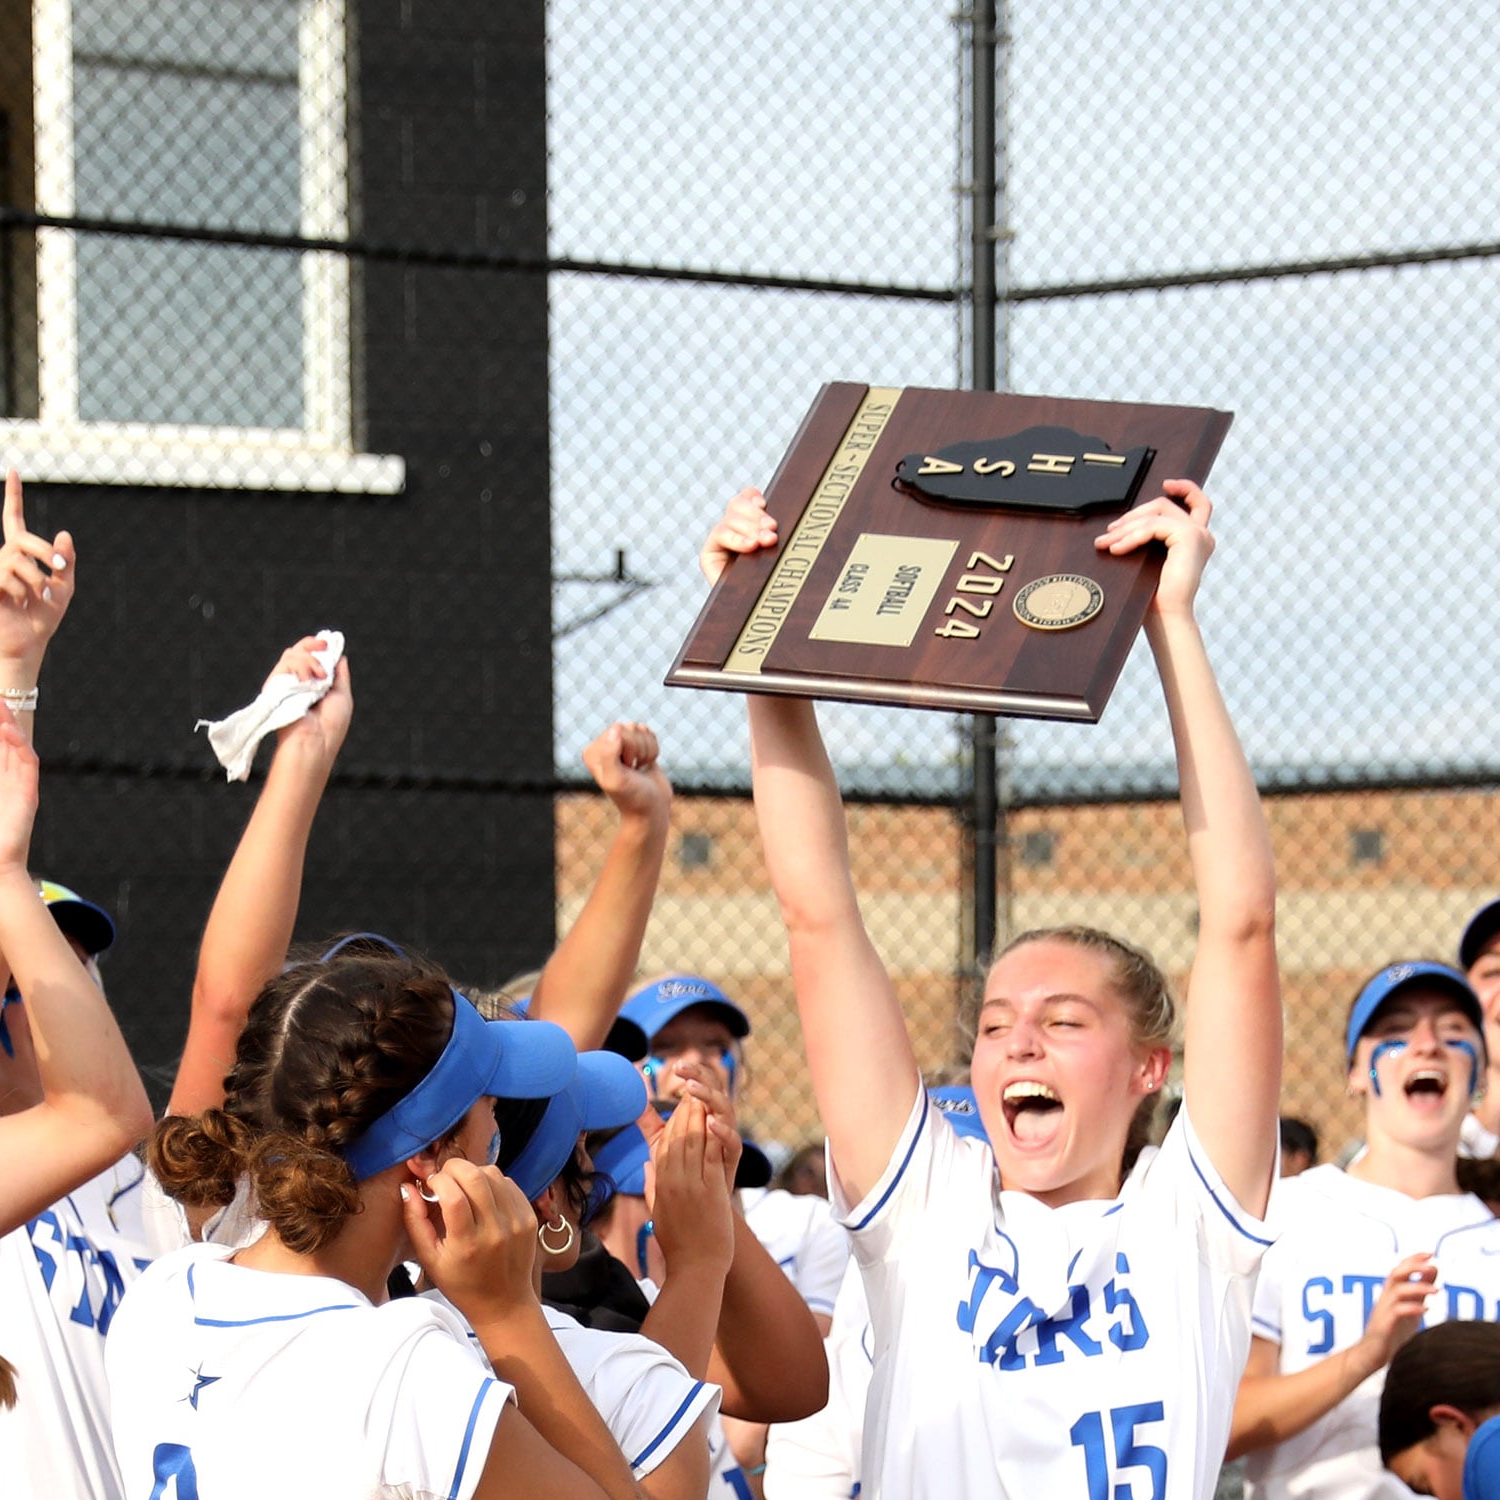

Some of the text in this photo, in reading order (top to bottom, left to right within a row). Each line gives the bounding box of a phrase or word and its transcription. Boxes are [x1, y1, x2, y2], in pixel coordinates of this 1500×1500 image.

[843, 402, 891, 452] SUPER
[791, 463, 861, 551] SECTIONAL
[737, 556, 812, 656] CHAMPIONS
[828, 562, 870, 611] CLASS 4A
[875, 564, 922, 616] SOFTBALL
[934, 551, 1015, 639] 2024
